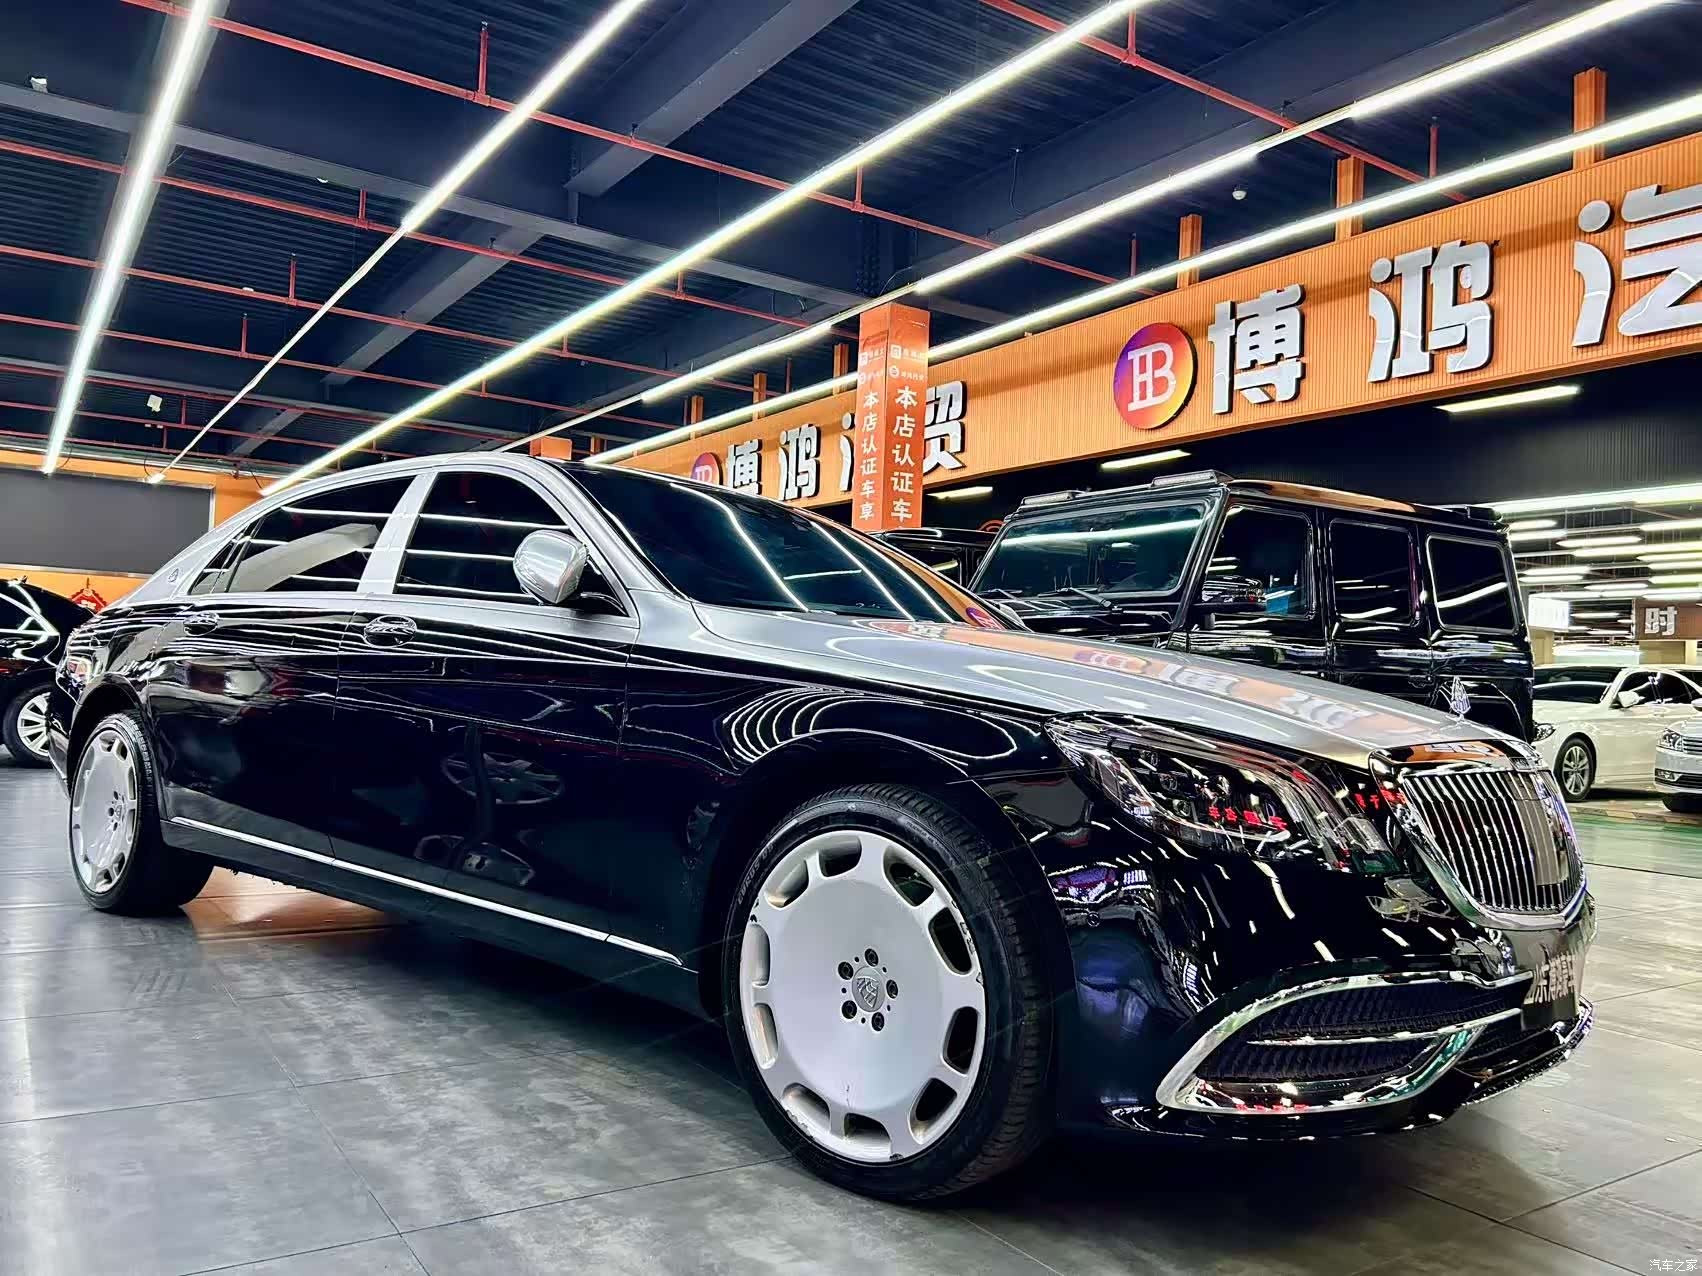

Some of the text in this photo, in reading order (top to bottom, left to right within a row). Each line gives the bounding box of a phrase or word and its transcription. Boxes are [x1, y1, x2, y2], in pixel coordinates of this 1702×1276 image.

[859, 390, 879, 521] 本店认证车享
[890, 385, 918, 527] 本店认证车
[1644, 606, 1678, 636] 时
